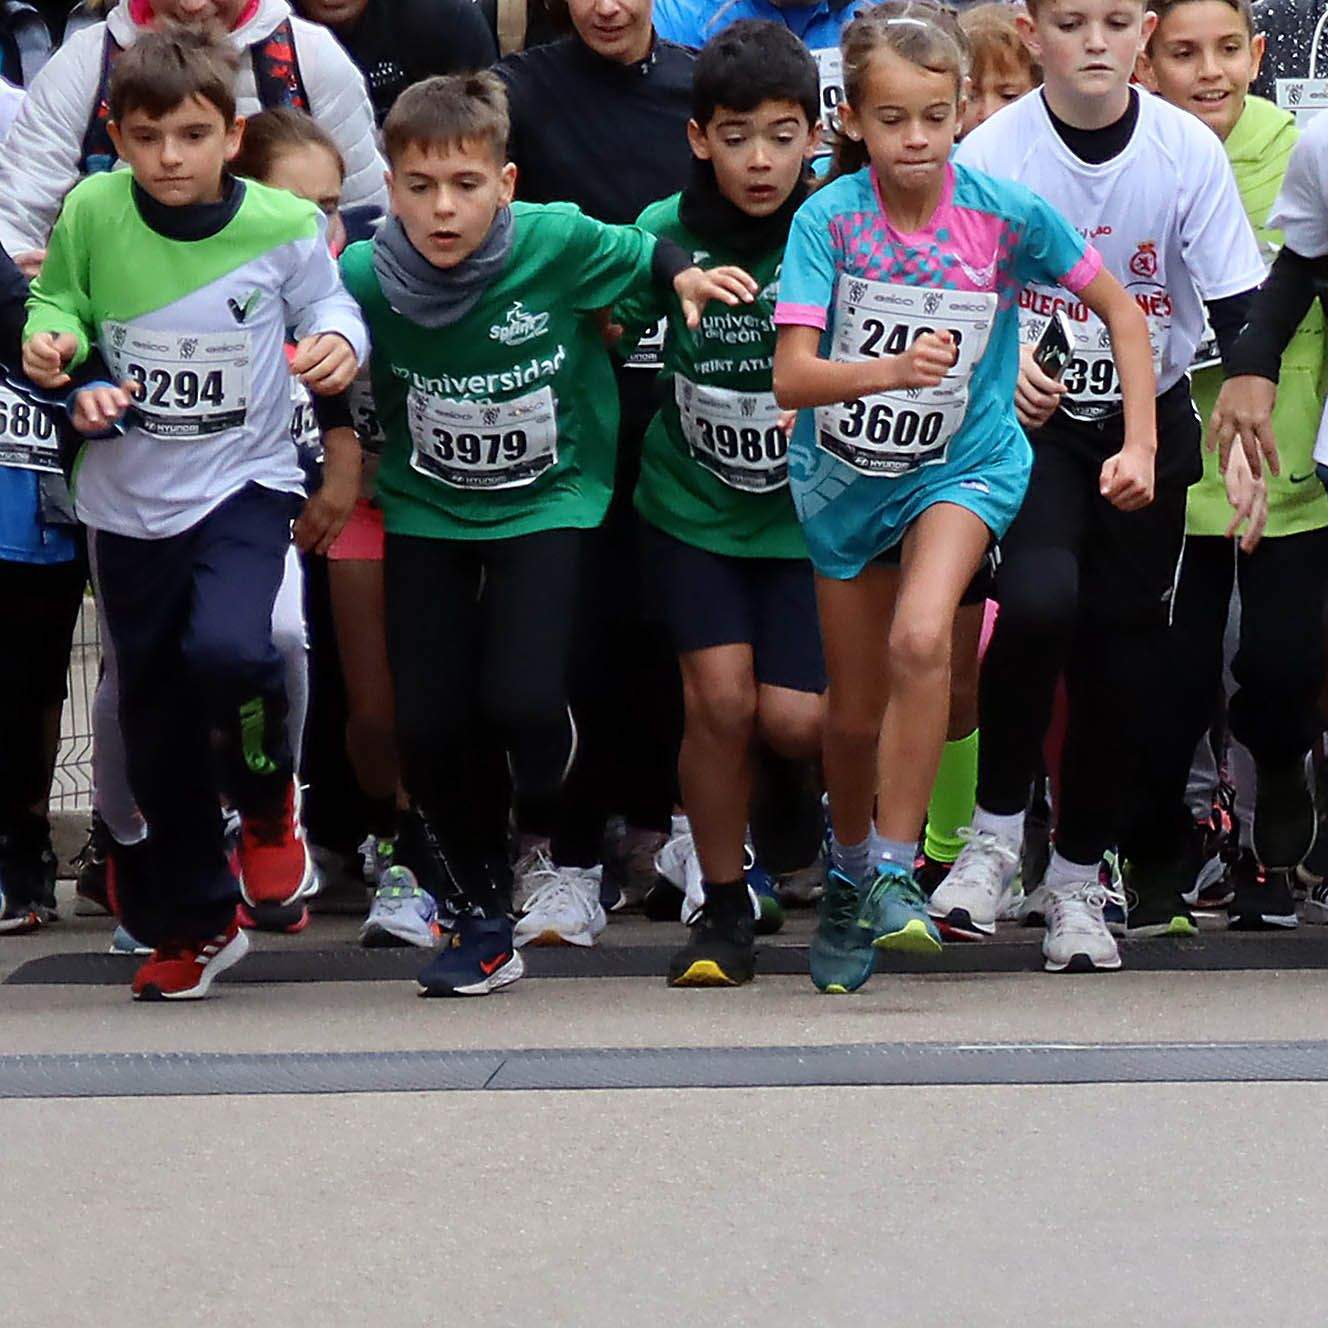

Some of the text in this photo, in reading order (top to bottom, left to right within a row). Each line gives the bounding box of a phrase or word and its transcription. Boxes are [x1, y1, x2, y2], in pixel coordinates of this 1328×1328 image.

[127, 363, 225, 410] 3294
[1063, 358, 1124, 395] 39
[431, 427, 528, 465] 3979
[695, 416, 788, 463] 3980
[838, 399, 945, 447] 3600
